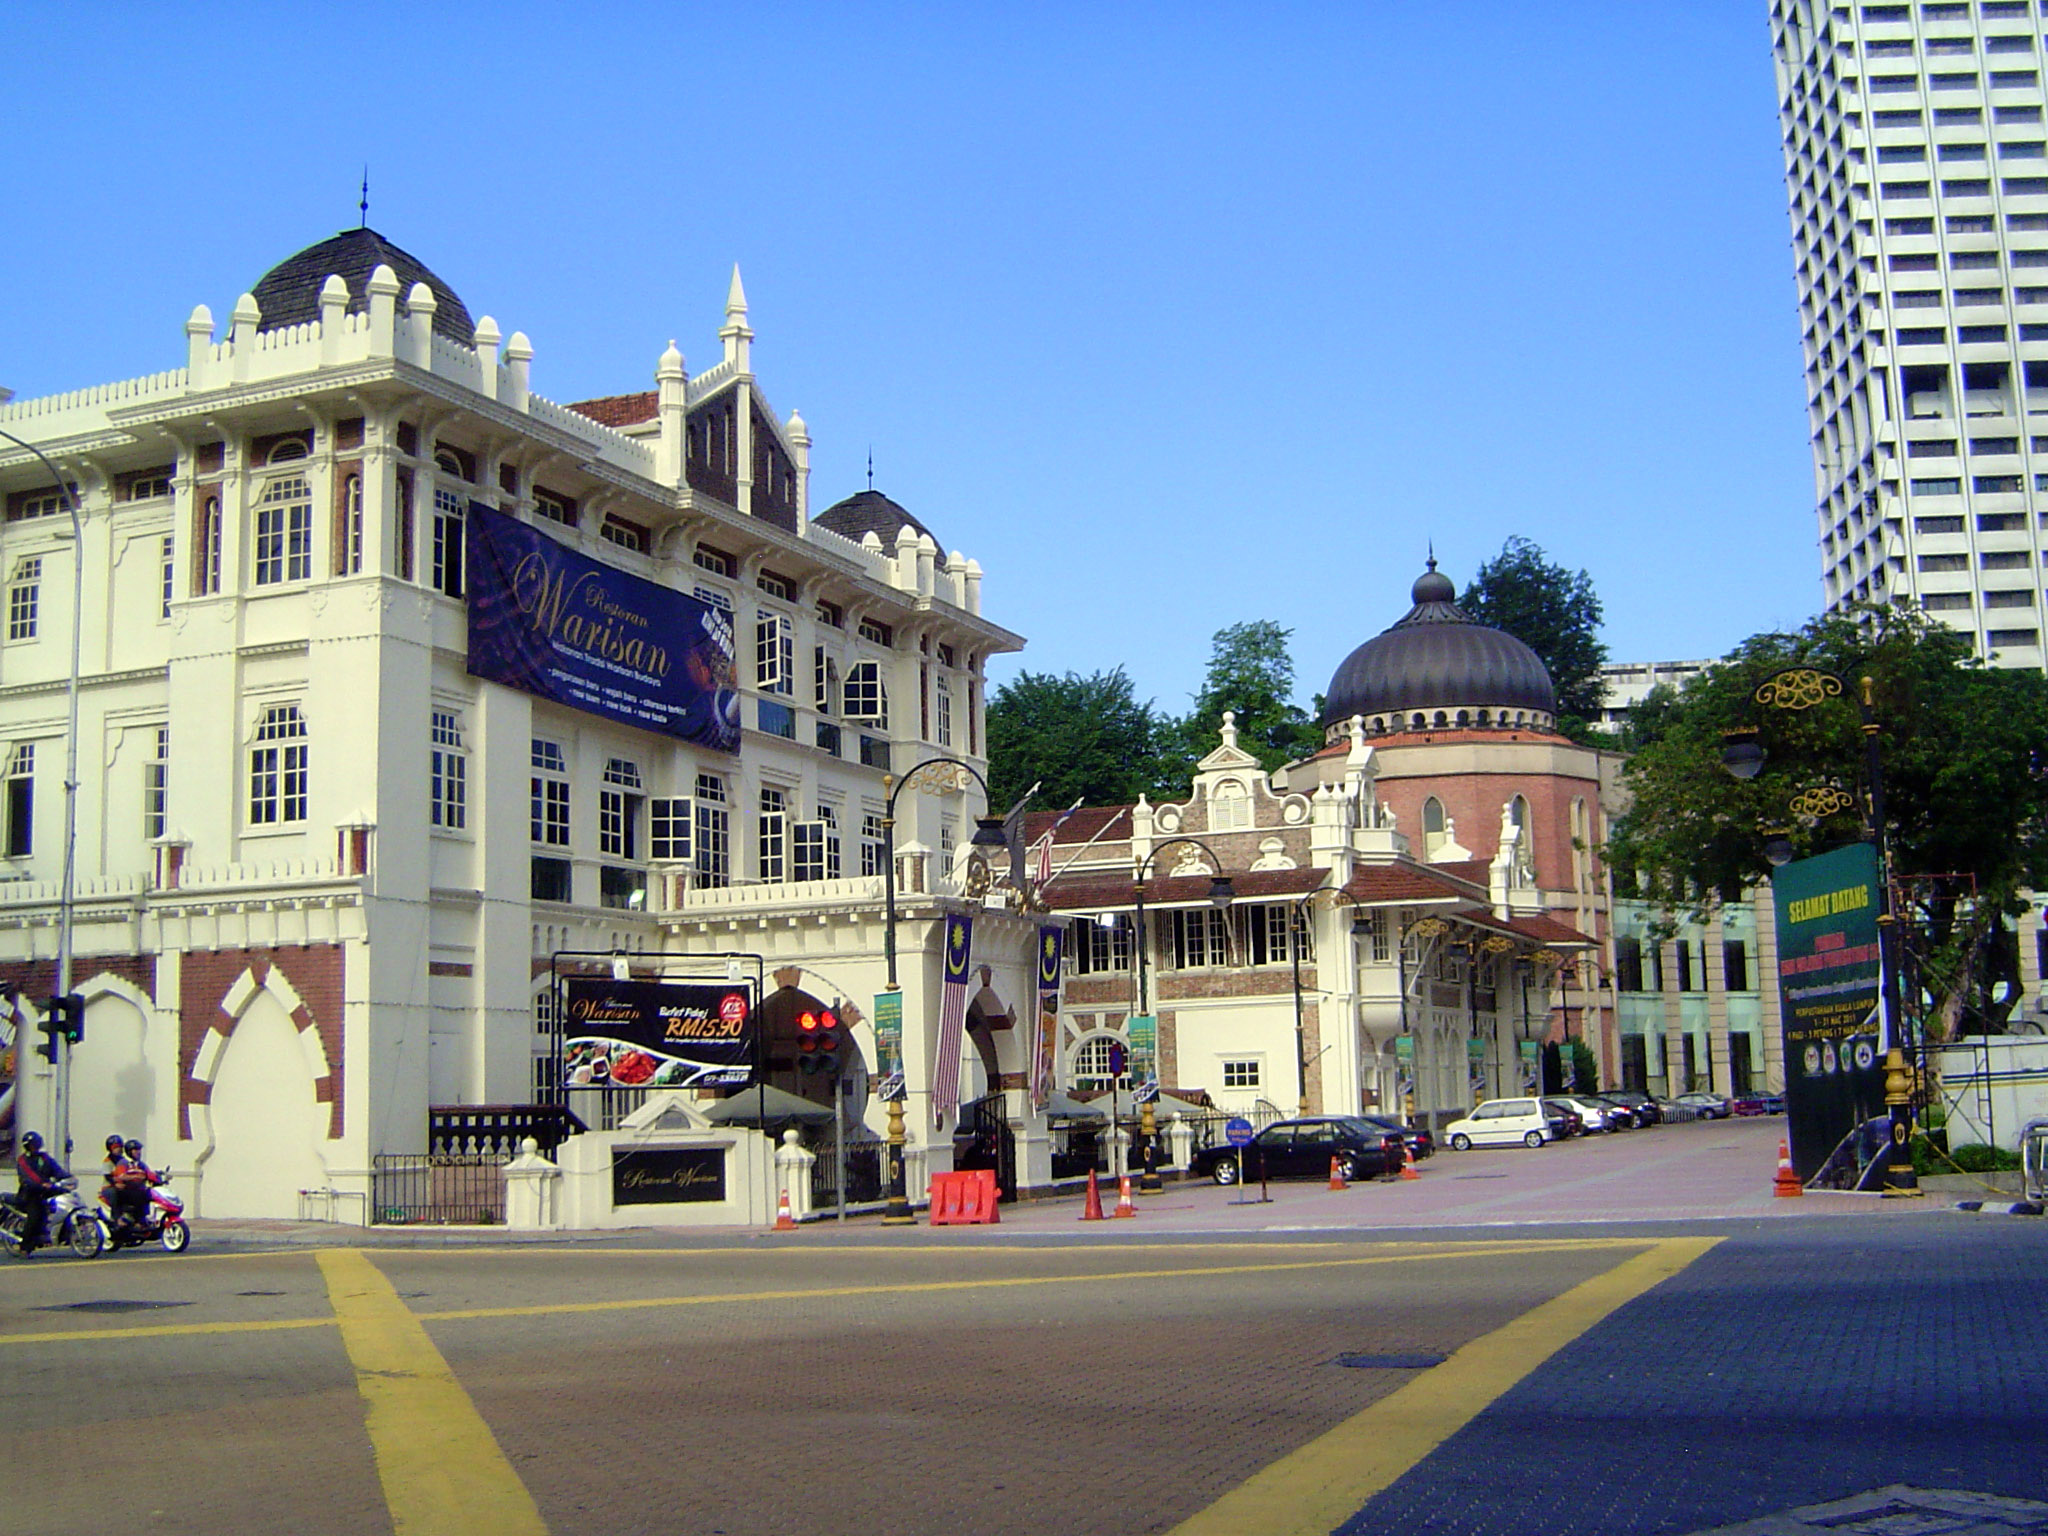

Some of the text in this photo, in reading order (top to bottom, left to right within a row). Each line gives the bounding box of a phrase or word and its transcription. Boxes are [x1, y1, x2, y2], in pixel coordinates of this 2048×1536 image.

[513, 552, 671, 677] Warisan
[586, 583, 648, 628] Restoran
[1789, 884, 1868, 924] SELAMAT DATANG
[572, 998, 640, 1019] Warisan
[666, 1017, 743, 1037] RM15.90
